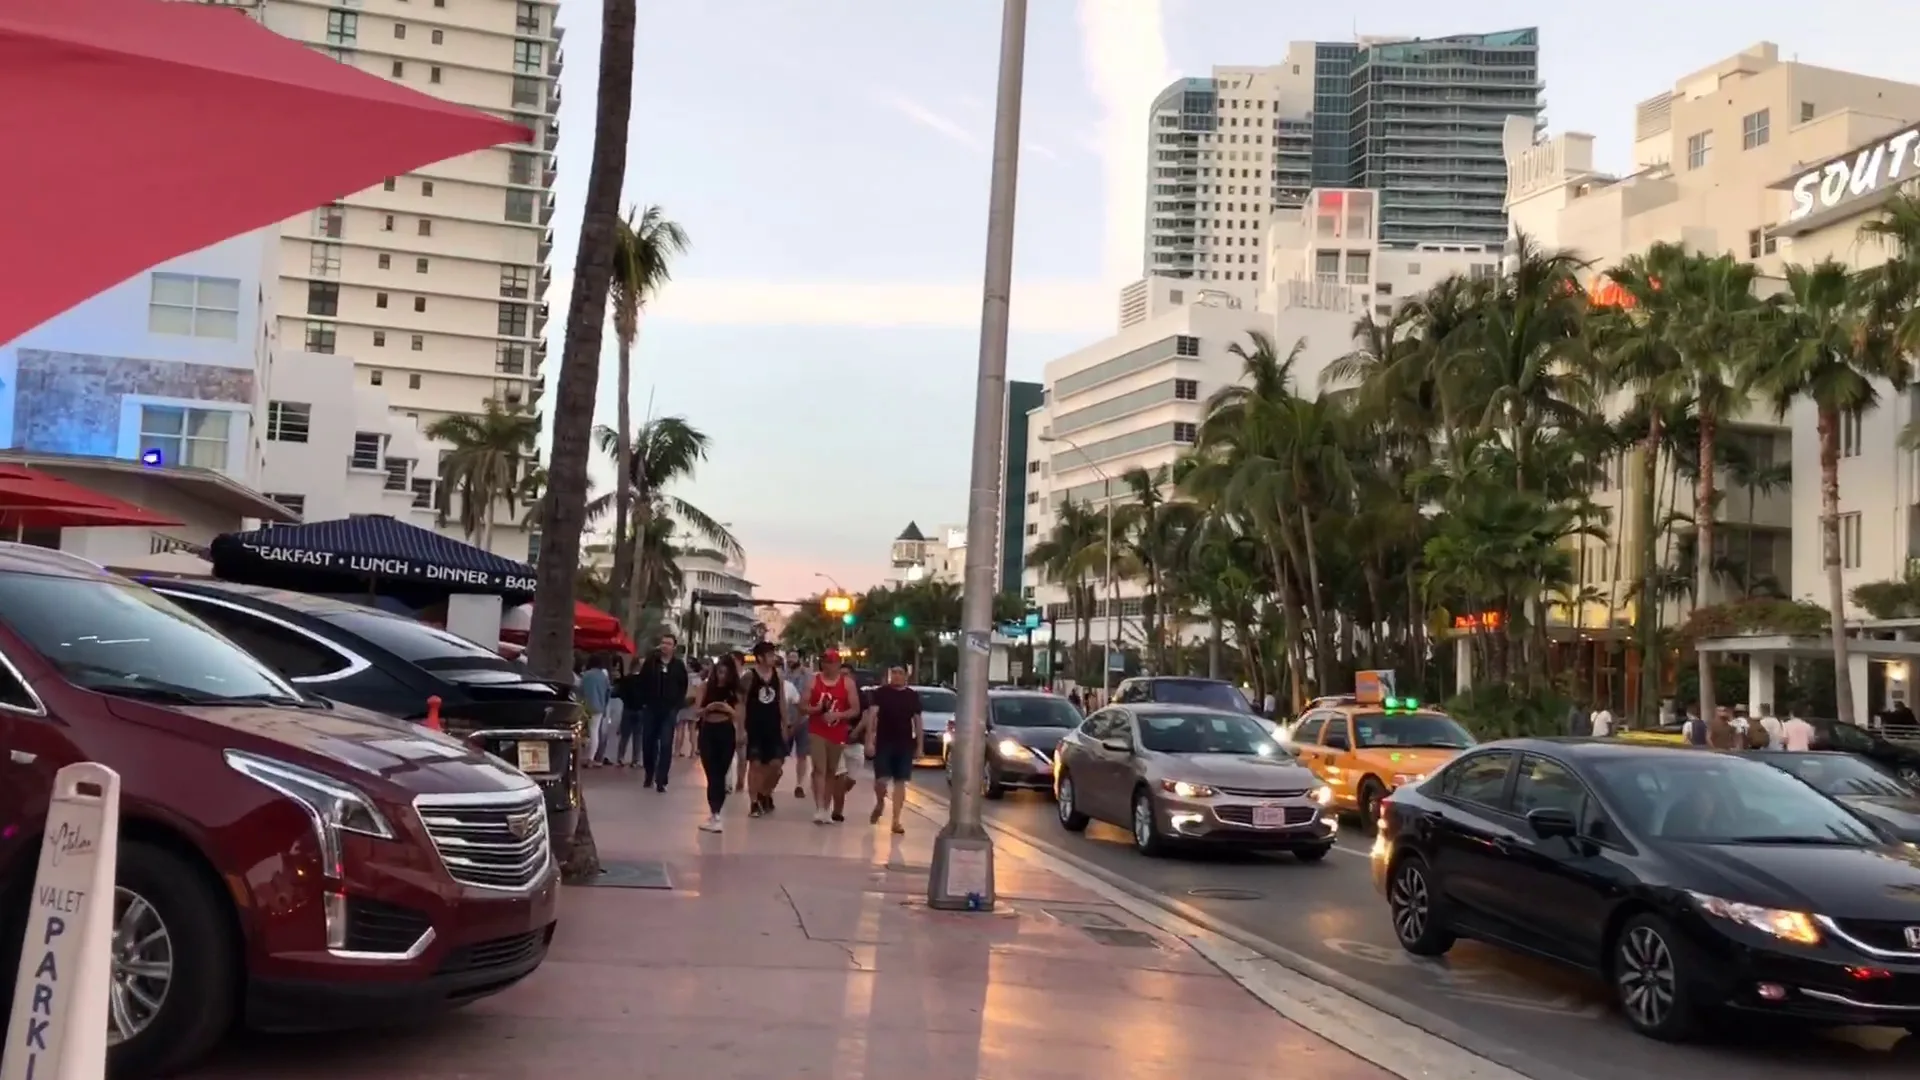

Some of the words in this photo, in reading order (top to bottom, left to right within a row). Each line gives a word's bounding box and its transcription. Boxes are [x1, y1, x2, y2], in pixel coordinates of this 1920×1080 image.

[350, 555, 409, 574] LUNCH
[426, 564, 488, 585] DINNER
[504, 574, 537, 592] BAR
[40, 885, 85, 914] VALET
[26, 916, 66, 1080] PARKI
